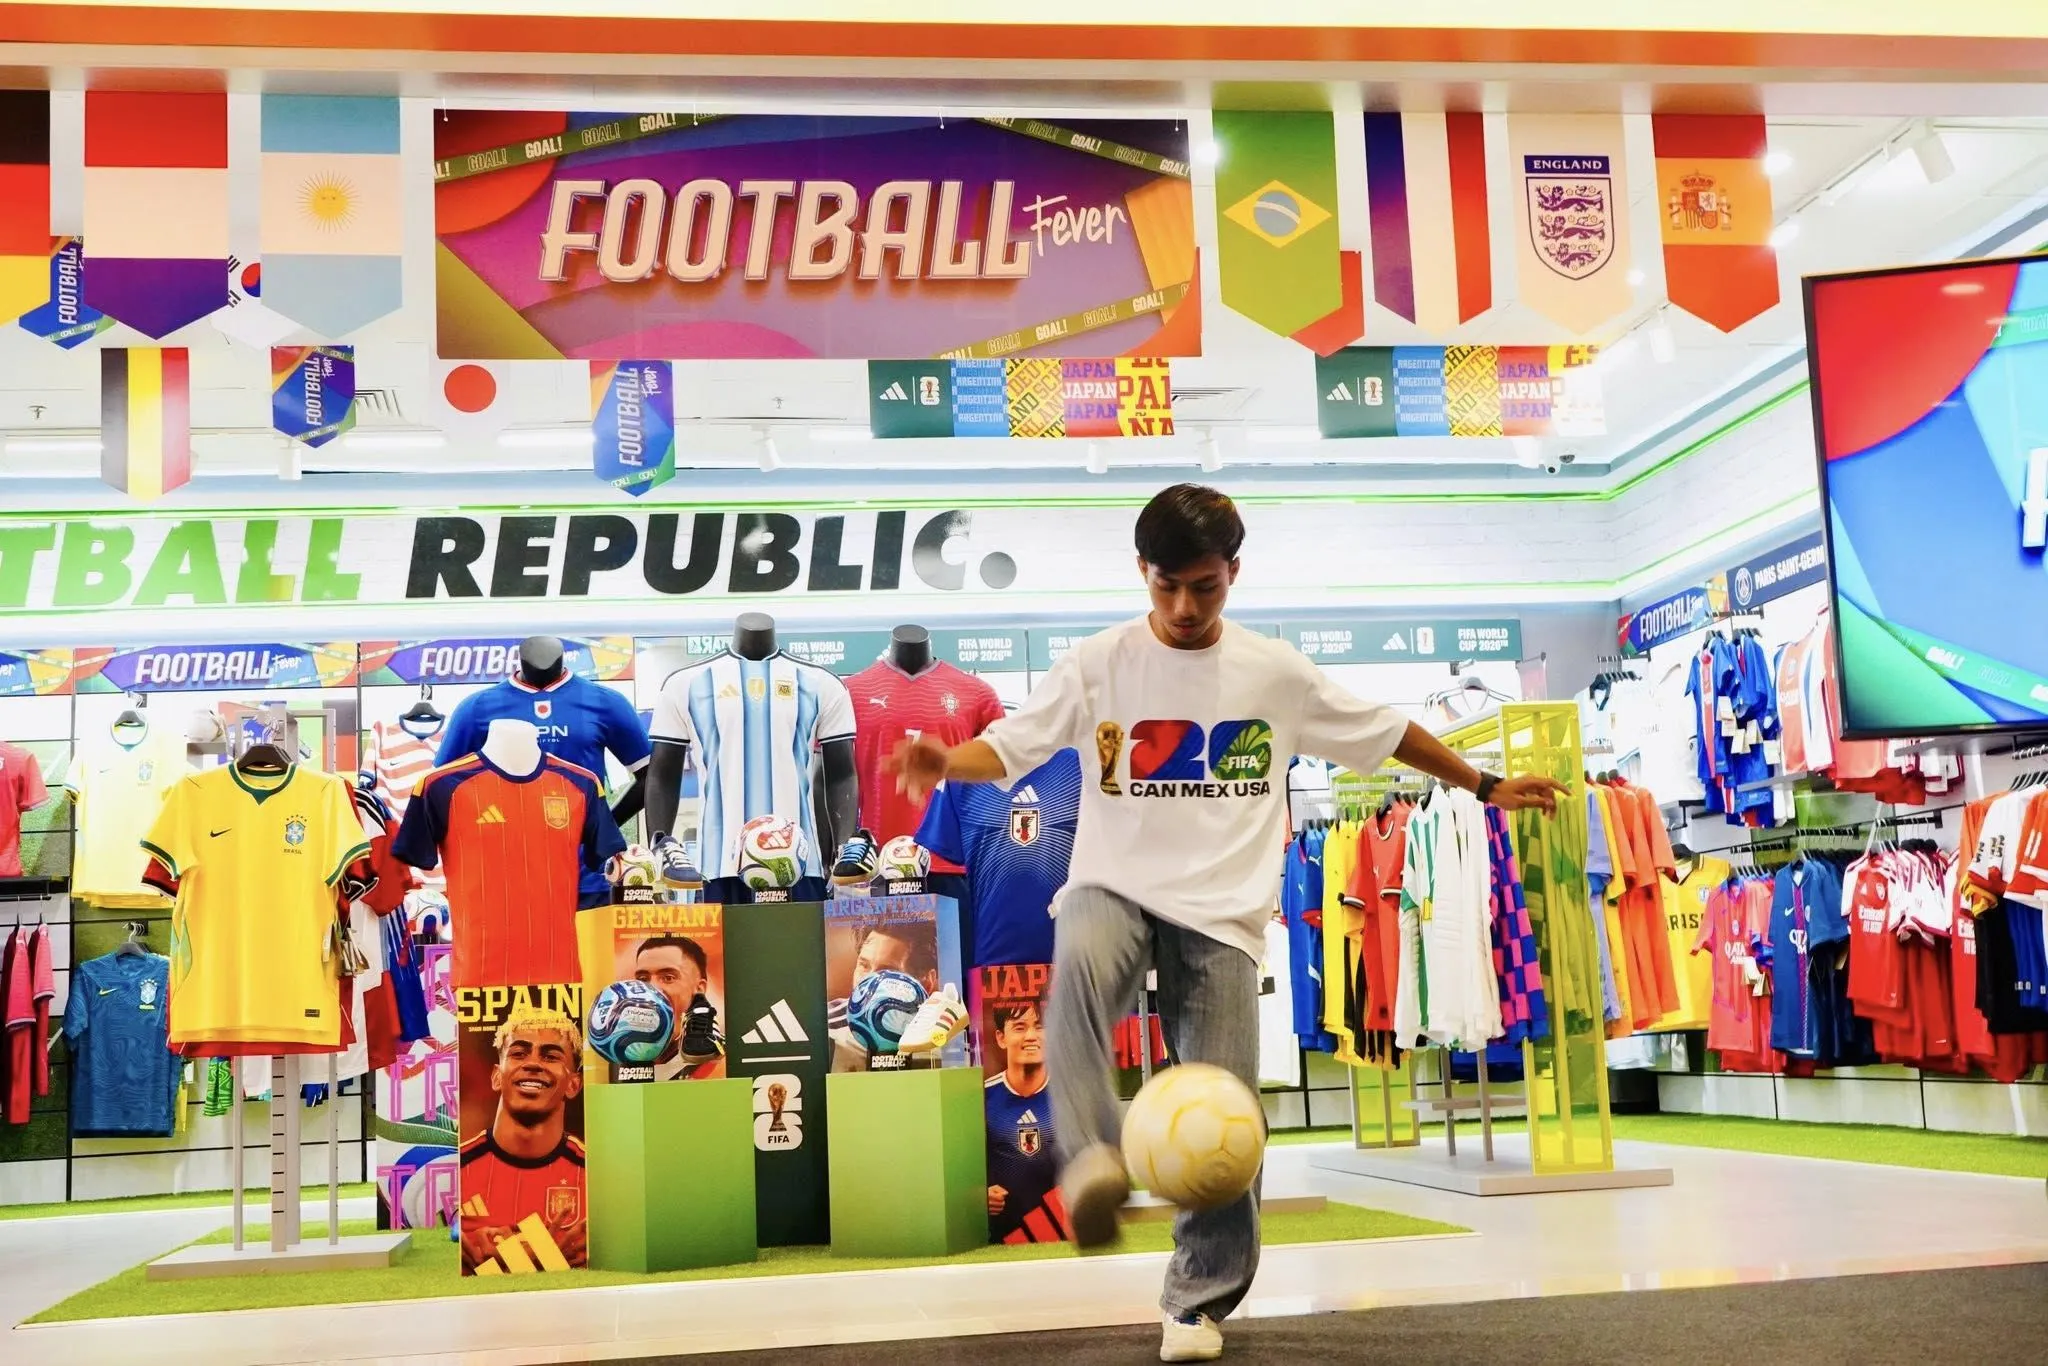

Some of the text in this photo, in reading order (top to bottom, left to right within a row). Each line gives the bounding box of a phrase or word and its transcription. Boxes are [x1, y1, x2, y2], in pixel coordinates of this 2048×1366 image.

[525, 136, 563, 159] GOAL!
[1071, 134, 1102, 152] GOAL!
[1160, 159, 1190, 177] GOAL!
[1533, 158, 1603, 171] ENGLAND
[538, 178, 1127, 283] FOOTBALL Fever
[58, 248, 77, 325] FOOTBALL
[1132, 291, 1164, 313] GOAL!
[1035, 319, 1068, 341] GOAL!
[1062, 363, 1115, 379] JAPAN
[1498, 363, 1549, 378] JAPAN
[304, 357, 322, 426] FOOTBALL
[1062, 382, 1117, 399] JAPAN
[1499, 382, 1551, 399] JAPAN
[615, 366, 662, 467] FOOTBALL Fever
[1064, 403, 1117, 420] JAPAN
[406, 510, 1017, 598] REPUBLIC.
[1754, 565, 1777, 590] PARIS
[1640, 594, 1693, 643] FOOTBALL
[1048, 637, 1069, 648] FIFA
[1300, 630, 1352, 642] FIFA WORLD
[1458, 628, 1508, 640] FIFA WORLD
[789, 640, 844, 653] FIFA WORLD
[958, 638, 1012, 650] FIFA WORLD
[1301, 643, 1320, 654] CUP
[1459, 640, 1477, 651] CUP
[959, 650, 979, 661] CUP
[134, 650, 303, 685] FOOTBALL Fever
[1228, 755, 1259, 770] FIFA
[1130, 781, 1271, 798] CAN MEX USA
[613, 904, 722, 929] GERMANY
[456, 983, 583, 1023] SPAIN
[768, 1135, 790, 1144] FIFA
